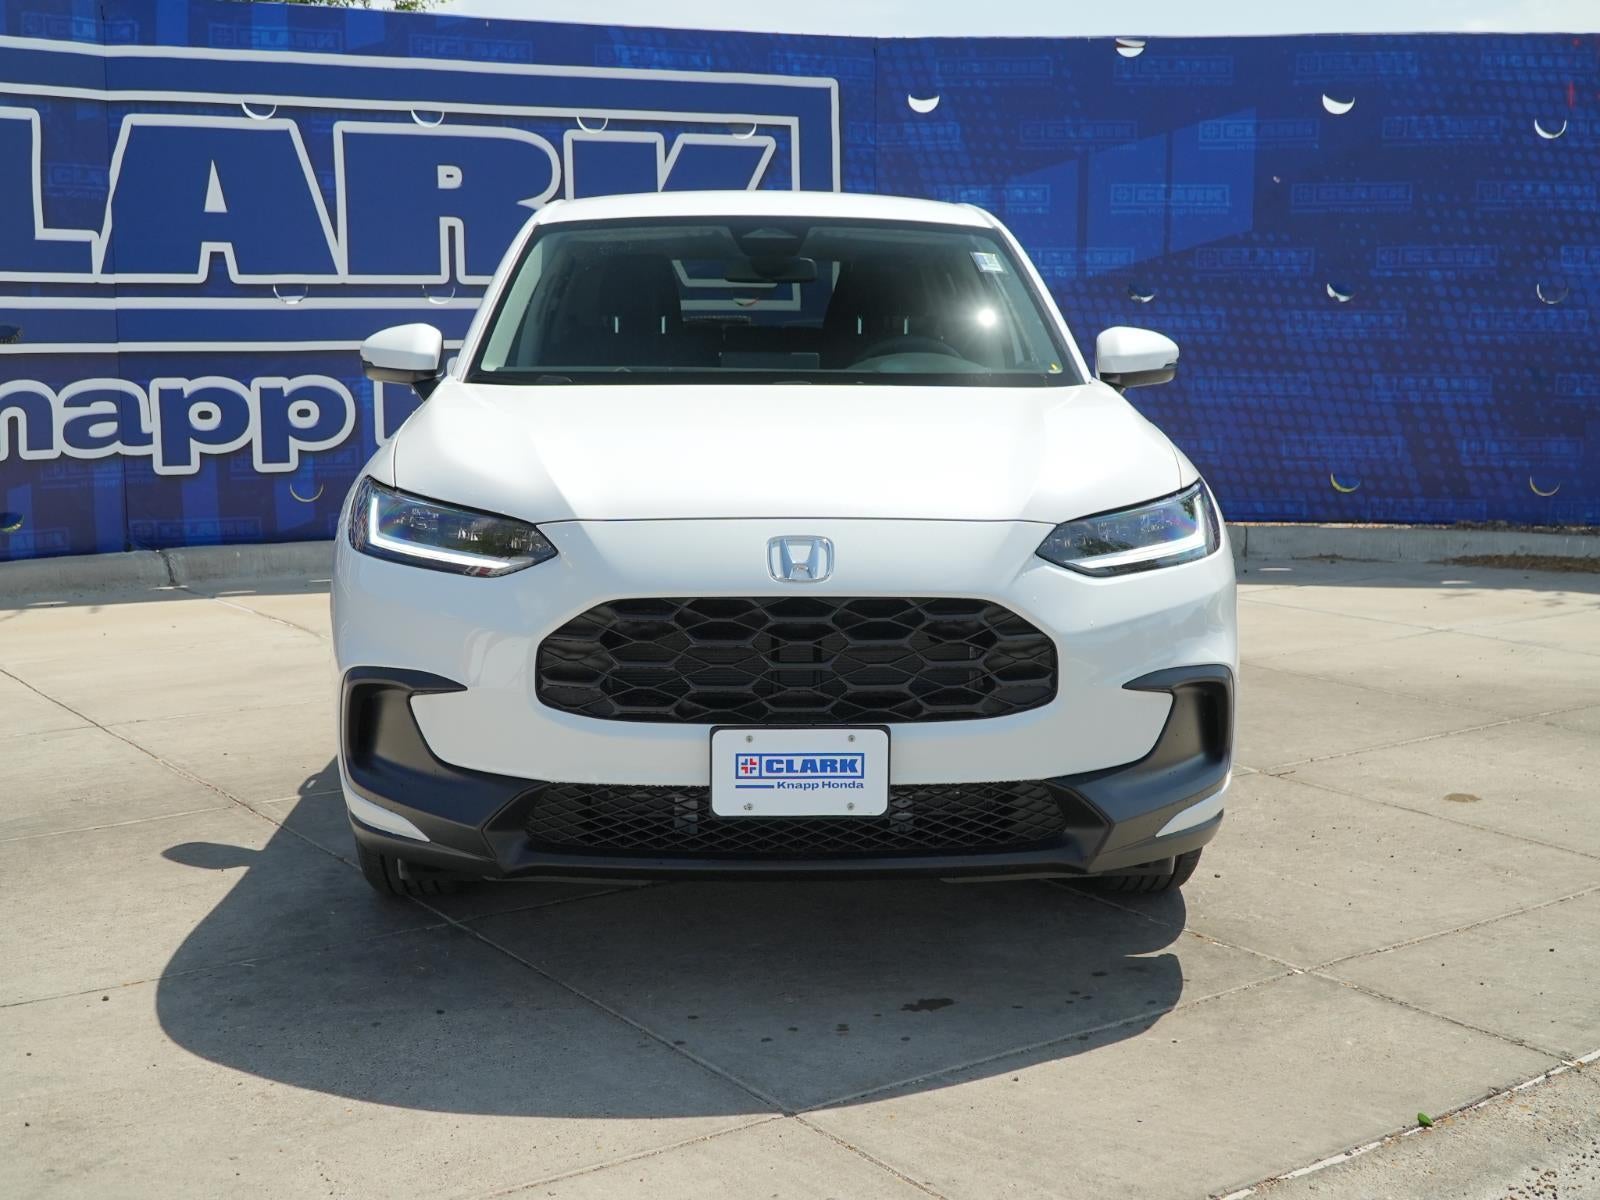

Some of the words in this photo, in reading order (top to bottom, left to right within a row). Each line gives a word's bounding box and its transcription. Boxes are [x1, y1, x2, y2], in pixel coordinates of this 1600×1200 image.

[765, 758, 858, 774] CLARK
[777, 781, 819, 791] Knapp
[821, 780, 864, 790] Honda
